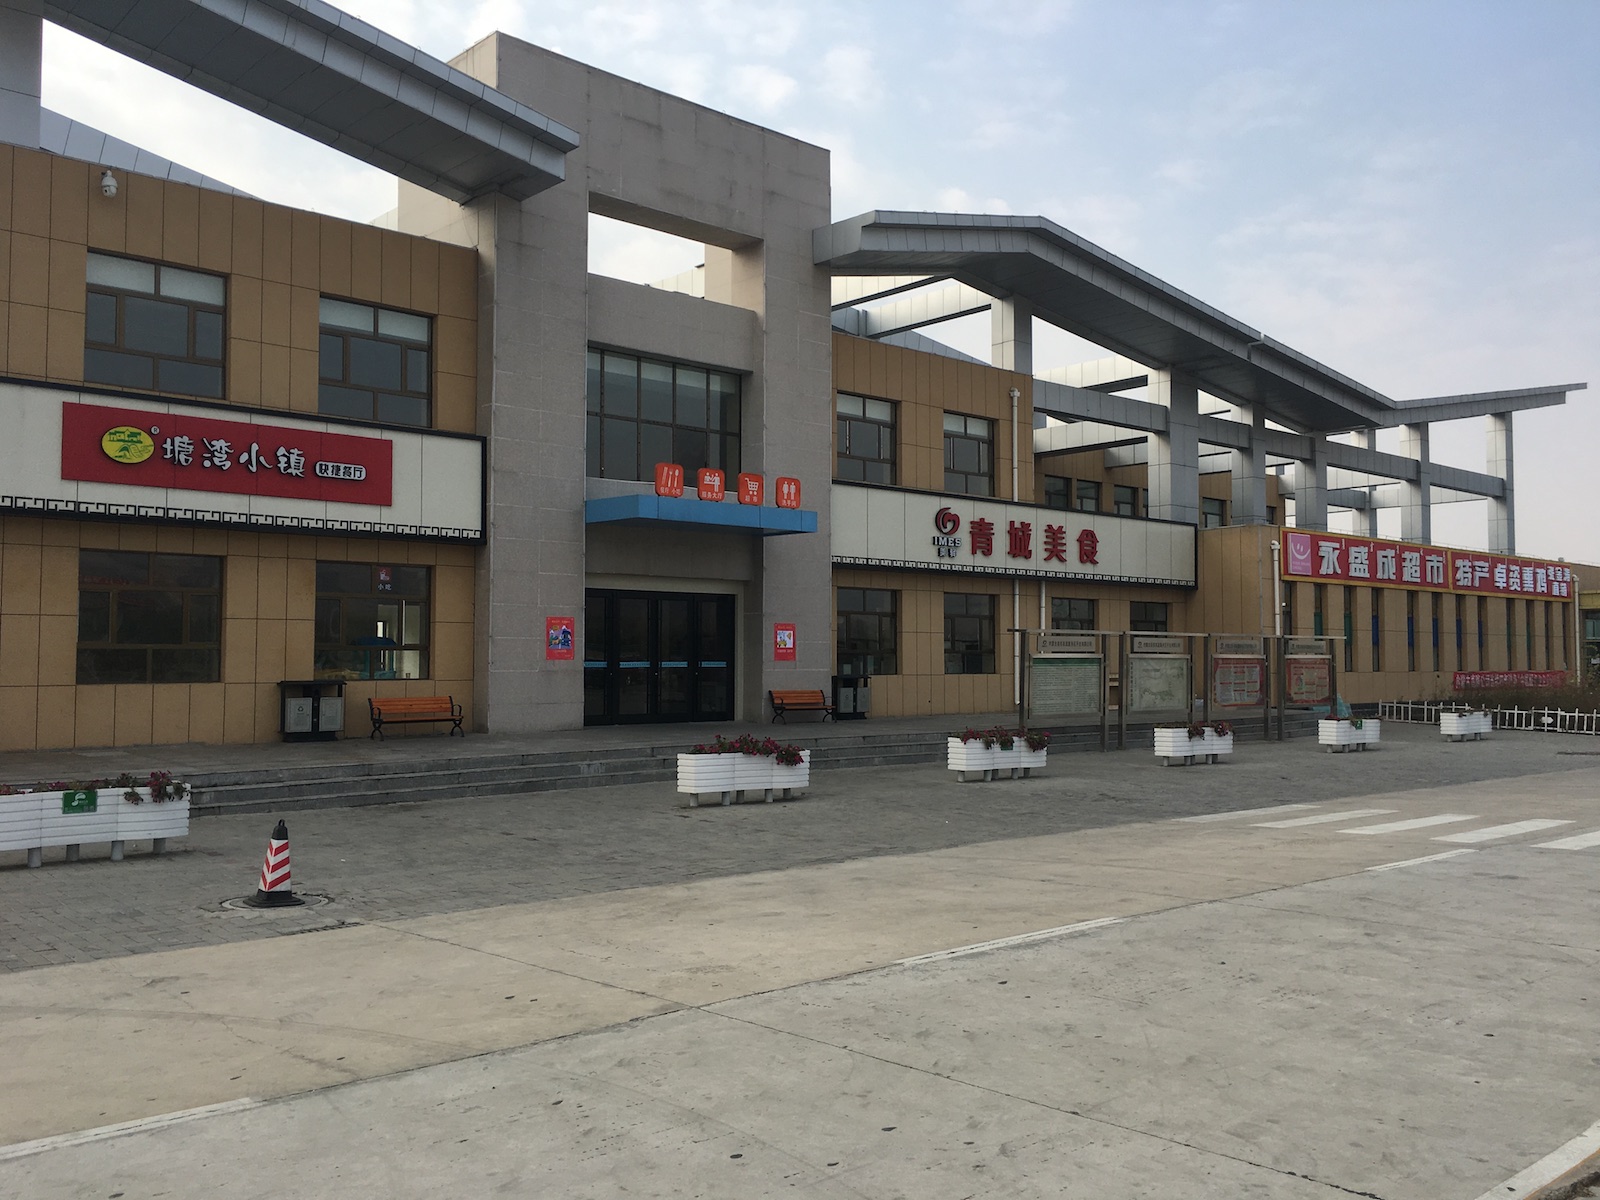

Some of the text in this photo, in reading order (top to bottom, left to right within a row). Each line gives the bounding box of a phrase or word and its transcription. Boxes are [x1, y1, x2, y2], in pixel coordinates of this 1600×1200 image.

[162, 435, 306, 478] 塘湾小镇
[317, 463, 365, 480] 快捷餐厅
[933, 536, 962, 547] IMES
[969, 517, 1100, 565] 青城美食
[1318, 540, 1444, 584] 永盛成超市
[1455, 559, 1490, 587] 特产
